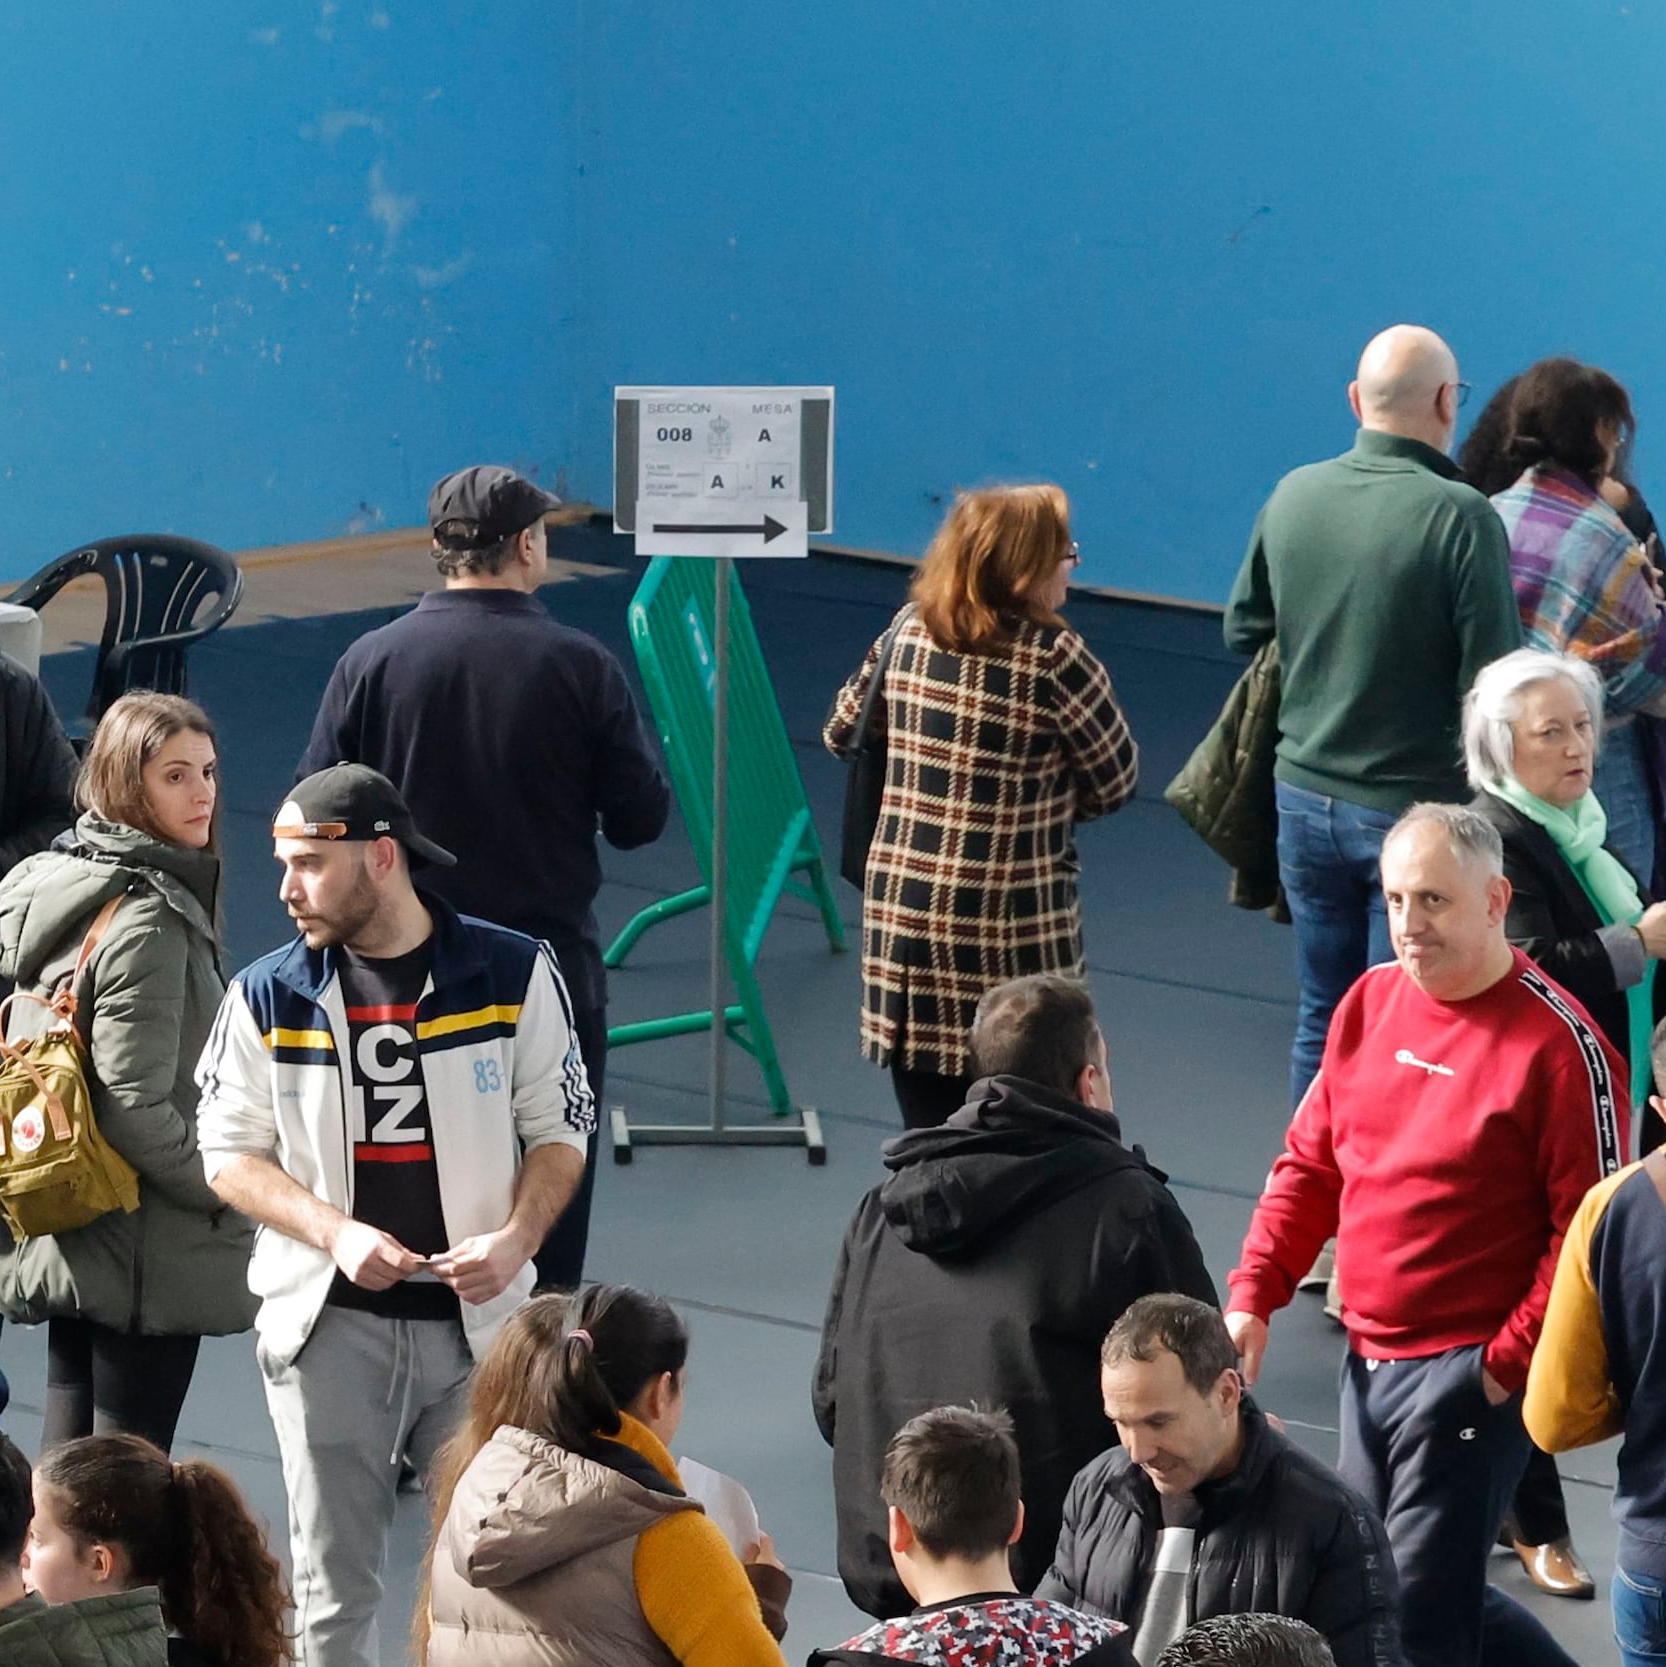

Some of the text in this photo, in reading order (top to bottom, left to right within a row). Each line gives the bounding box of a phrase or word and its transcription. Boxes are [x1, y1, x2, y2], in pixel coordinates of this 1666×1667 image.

[751, 403, 793, 415] MESA
[656, 427, 693, 442] 008
[757, 428, 772, 443] A
[710, 475, 724, 489] A
[770, 475, 785, 489] K
[472, 1057, 502, 1094] 83
